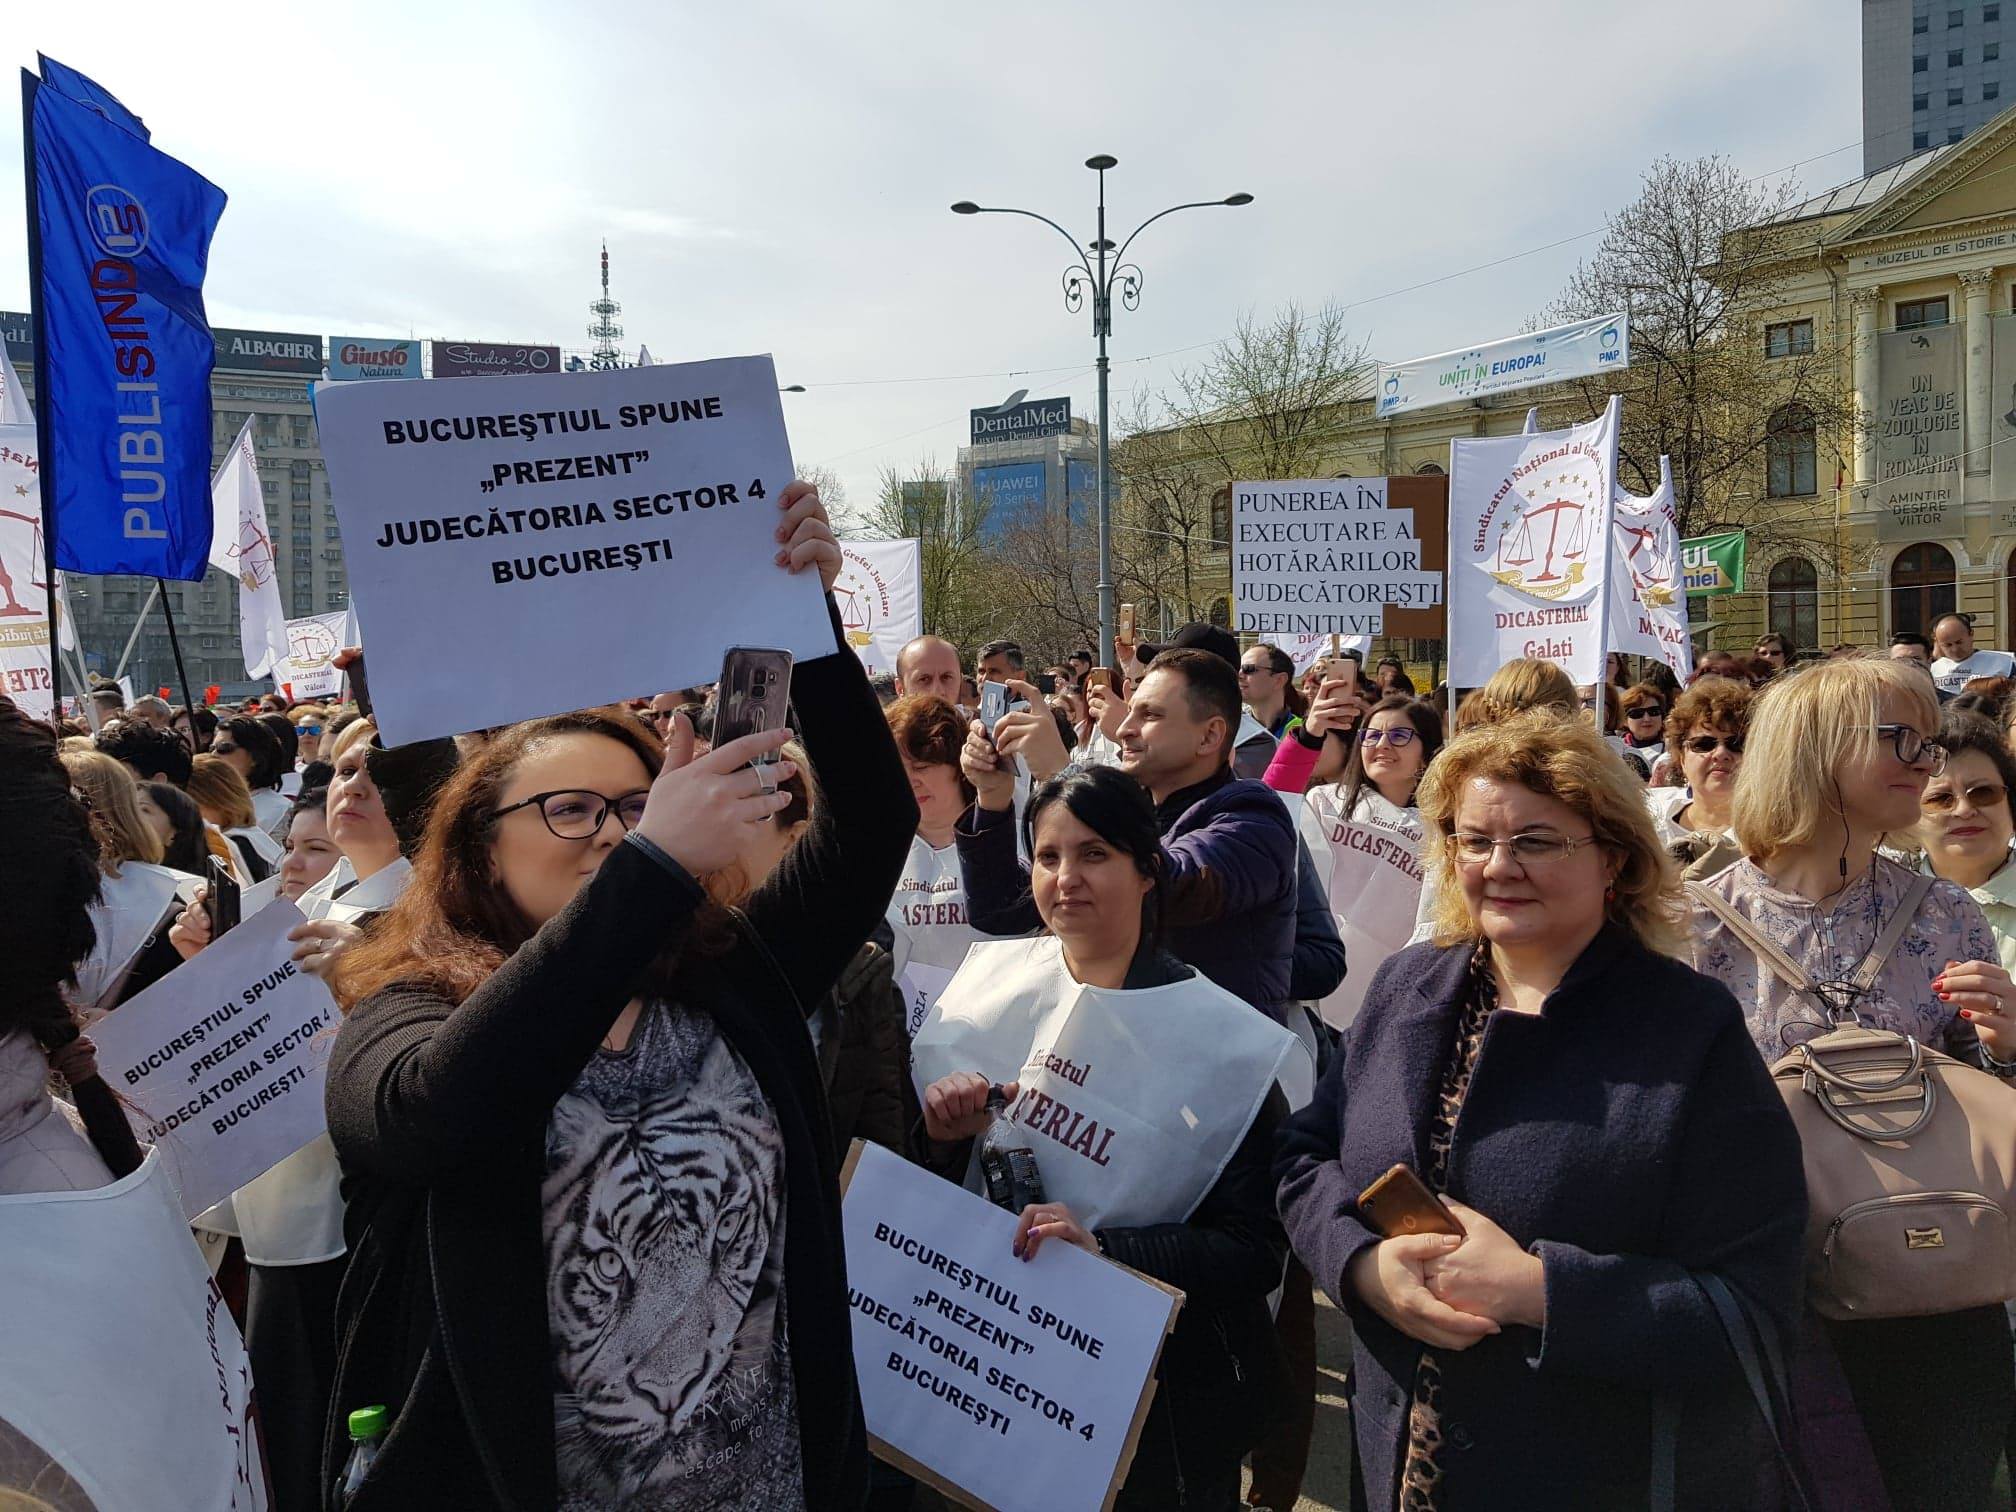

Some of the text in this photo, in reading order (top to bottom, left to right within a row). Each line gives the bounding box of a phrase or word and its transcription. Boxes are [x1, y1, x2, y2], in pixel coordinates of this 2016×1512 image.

[1877, 249, 1928, 265] MUZEUL
[1933, 245, 1951, 256] DE
[1956, 234, 2006, 252] ISTORIE
[230, 338, 318, 360] ALBACHER
[341, 343, 408, 367] Giusto
[446, 345, 510, 365] Studio
[1599, 350, 1620, 363] PMP
[360, 366, 404, 378] Natura
[1492, 352, 1546, 376] EUROPA!
[1910, 374, 1932, 393] UN
[90, 259, 167, 539] PUBLISIND
[1889, 391, 1955, 416] VEAC DE
[383, 396, 724, 445] BUCUREŞTIUL SPUNE
[972, 404, 1067, 434] DentalMed
[1884, 411, 1960, 437] ZOOLOGIE
[1009, 429, 1038, 441] Dental
[980, 476, 1038, 493] HUAWEI
[1473, 478, 1513, 553] Sindicatul
[1571, 440, 1583, 455] al
[1888, 488, 1952, 504] AMINTIRI
[1238, 484, 1384, 513] PUNEREA ÎN
[1893, 501, 1947, 515] DESPRE
[376, 478, 766, 548] JUDECĂTORIA SECTOR 4
[1898, 513, 1942, 526] VIITOR
[1239, 521, 1411, 543] EXECUTARE A
[491, 538, 674, 585] BUCUREŞTI
[1239, 547, 1419, 573] HOTĂRÂRILOR
[843, 548, 890, 618] Grefei Judiciare
[1240, 612, 1382, 634] DEFINITIVE
[1495, 604, 1589, 629] DICASTERIAL
[1370, 815, 1424, 842] Sindicatul
[901, 877, 958, 893] Sindicatul
[124, 959, 297, 1086] BUCUREŞTIUL SPUNE
[146, 1062, 263, 1143] JUDECĂTORIA
[263, 1017, 323, 1065] SECTOR
[211, 1065, 307, 1136] BUCUREŞTI
[874, 1222, 1105, 1360] BUCUREŞTIUL SPUNE
[848, 1287, 1096, 1442] UDECĂTORIA SECTOR 4
[886, 1351, 1012, 1436] BUCUREŞTI
[684, 1441, 742, 1480] escape
